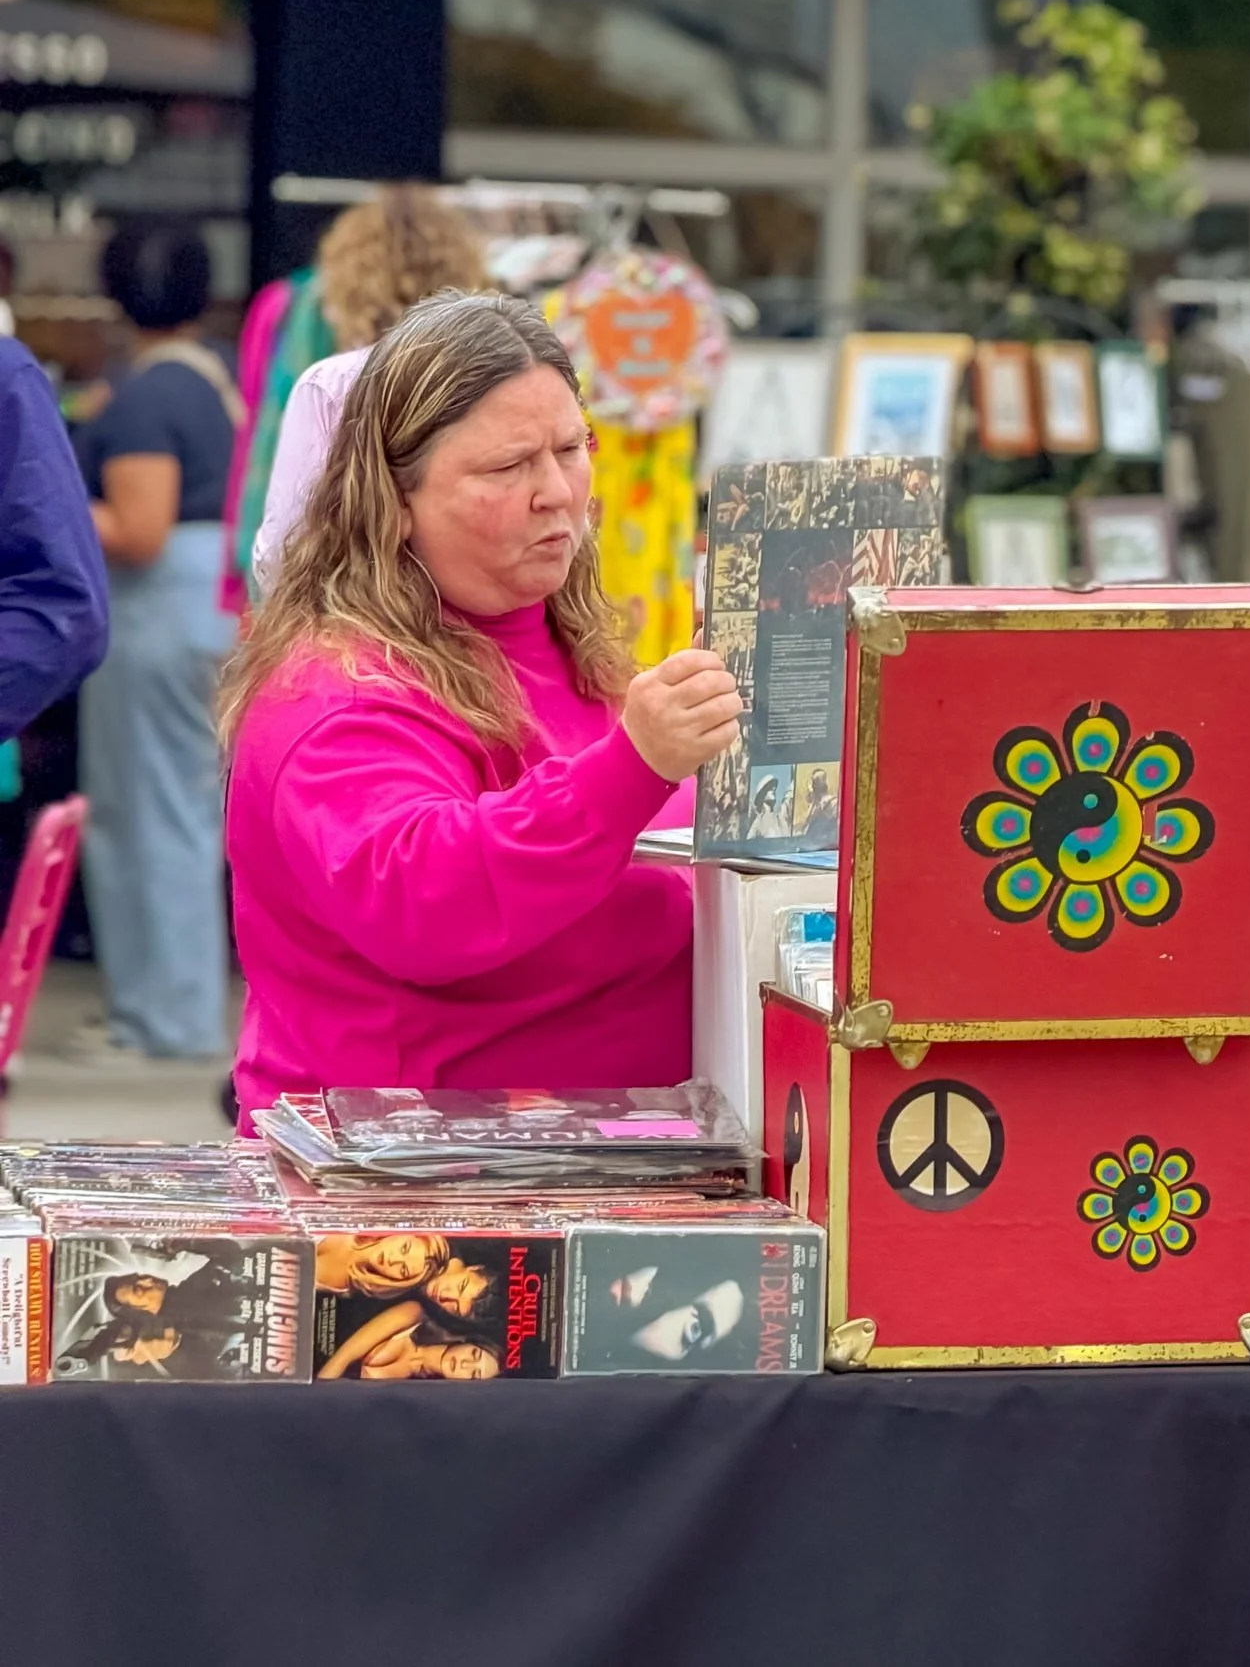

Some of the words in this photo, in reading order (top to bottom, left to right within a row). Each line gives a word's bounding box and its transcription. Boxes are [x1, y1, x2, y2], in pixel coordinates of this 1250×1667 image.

[28, 1271, 42, 1315] STEAMY
[29, 1242, 42, 1268] HOT
[265, 1247, 299, 1375] SANCTUARY
[507, 1247, 528, 1368] INTENTIONS
[523, 1275, 541, 1338] CRUEL
[755, 1275, 788, 1372] DREAMS
